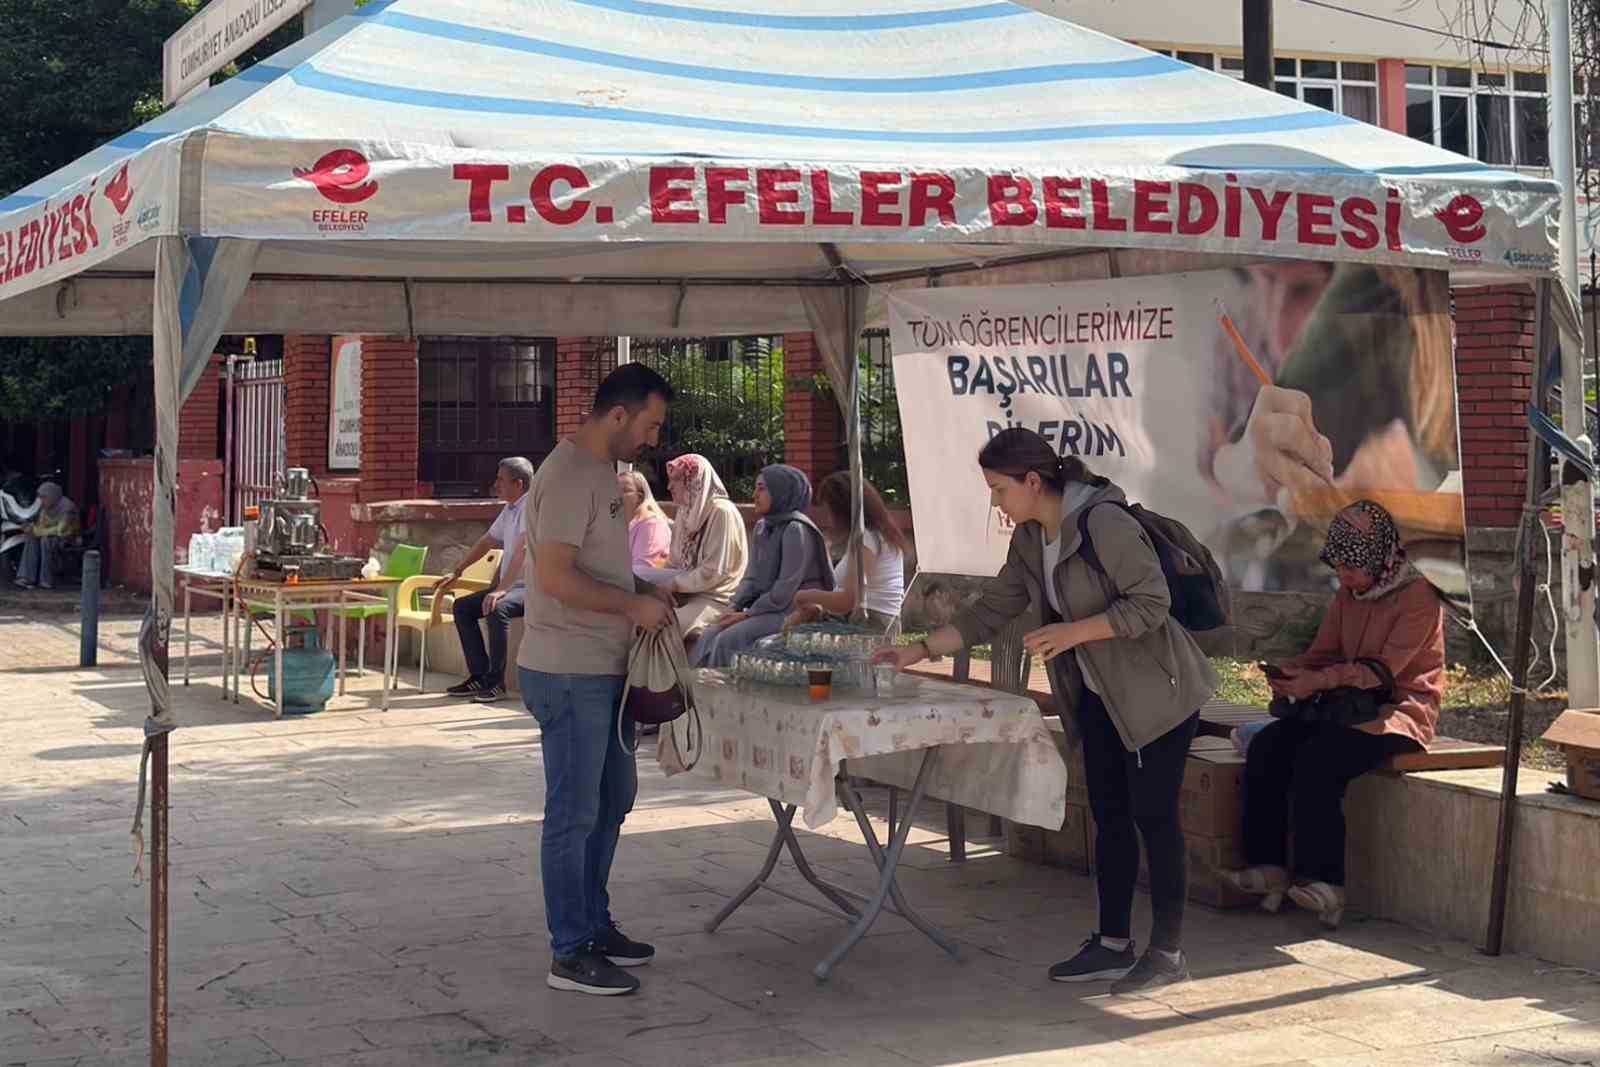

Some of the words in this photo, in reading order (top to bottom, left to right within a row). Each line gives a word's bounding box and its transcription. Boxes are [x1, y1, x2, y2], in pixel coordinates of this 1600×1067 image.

[313, 210, 368, 223] EFELER
[453, 163, 613, 225] T.C.
[648, 166, 957, 229] EFELER
[986, 172, 1403, 252] BELEDİYESİ
[947, 352, 1132, 408] BAŞARILAR
